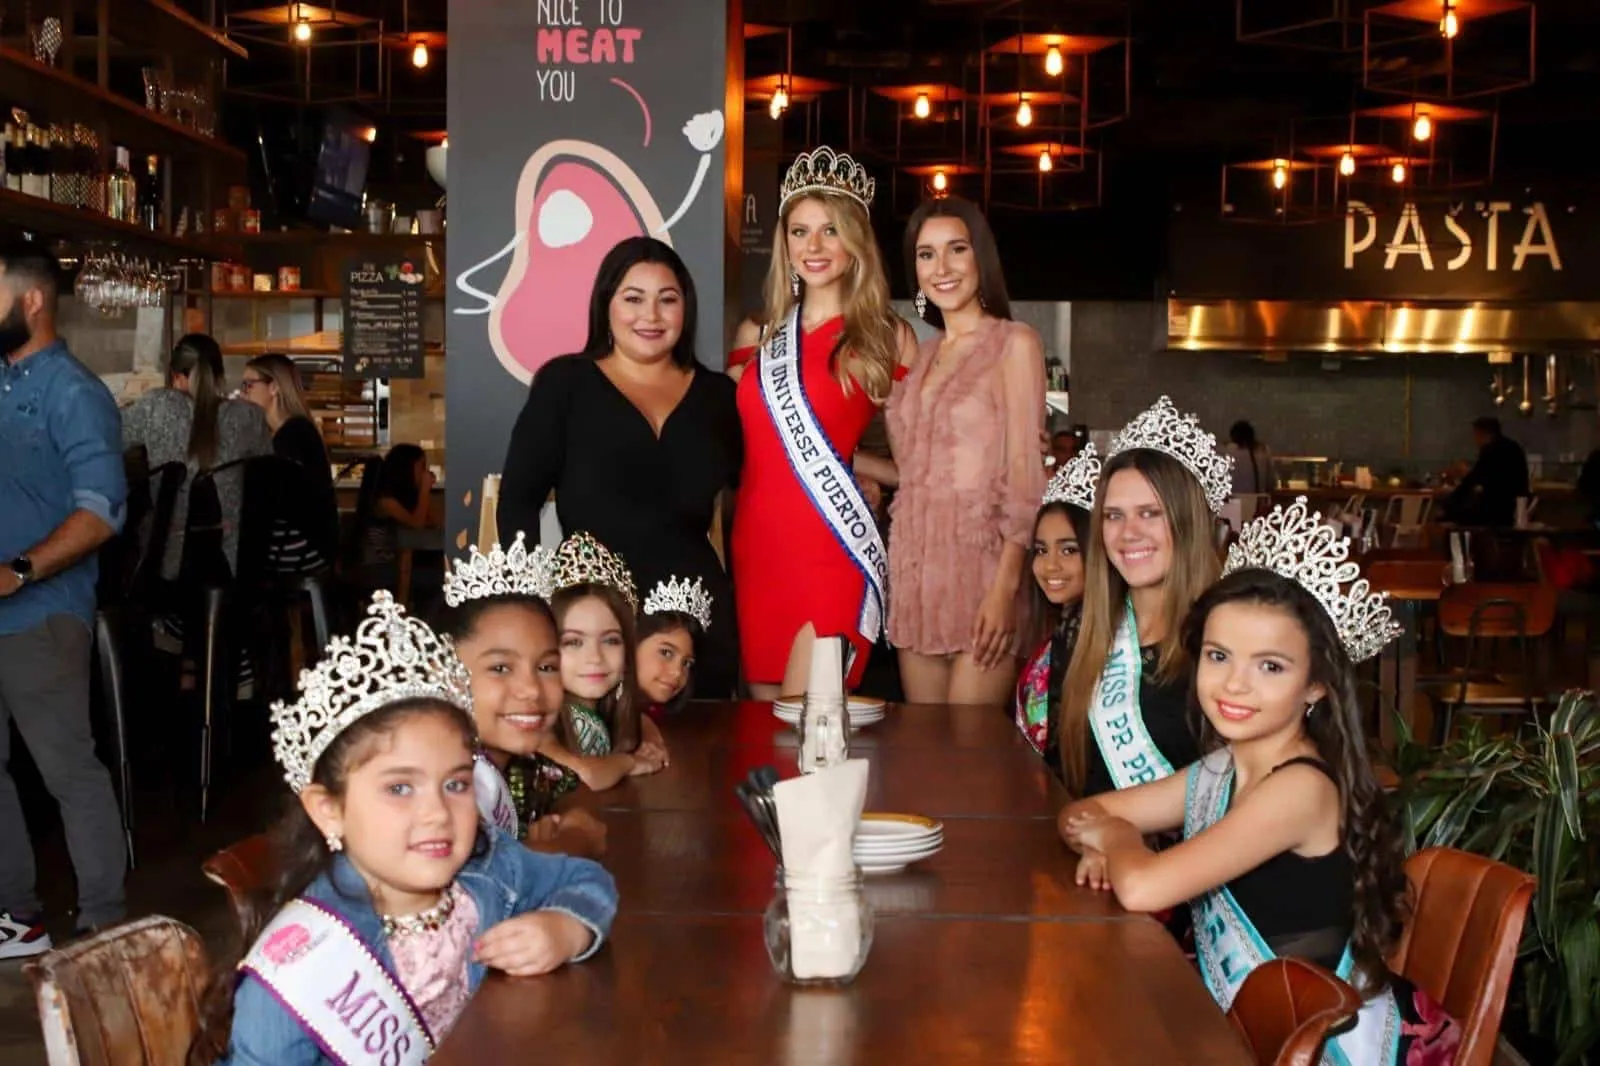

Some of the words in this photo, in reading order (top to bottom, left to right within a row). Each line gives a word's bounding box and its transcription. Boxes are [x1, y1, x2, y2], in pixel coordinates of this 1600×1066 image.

[537, 28, 643, 64] MEAT
[536, 69, 575, 102] YOU
[1344, 200, 1562, 270] PASTA
[350, 271, 384, 283] PIZZA
[771, 363, 820, 463] UNIVERSE
[814, 465, 866, 539] PUERTO
[1106, 712, 1134, 751] PR
[324, 969, 411, 1066] MISS
